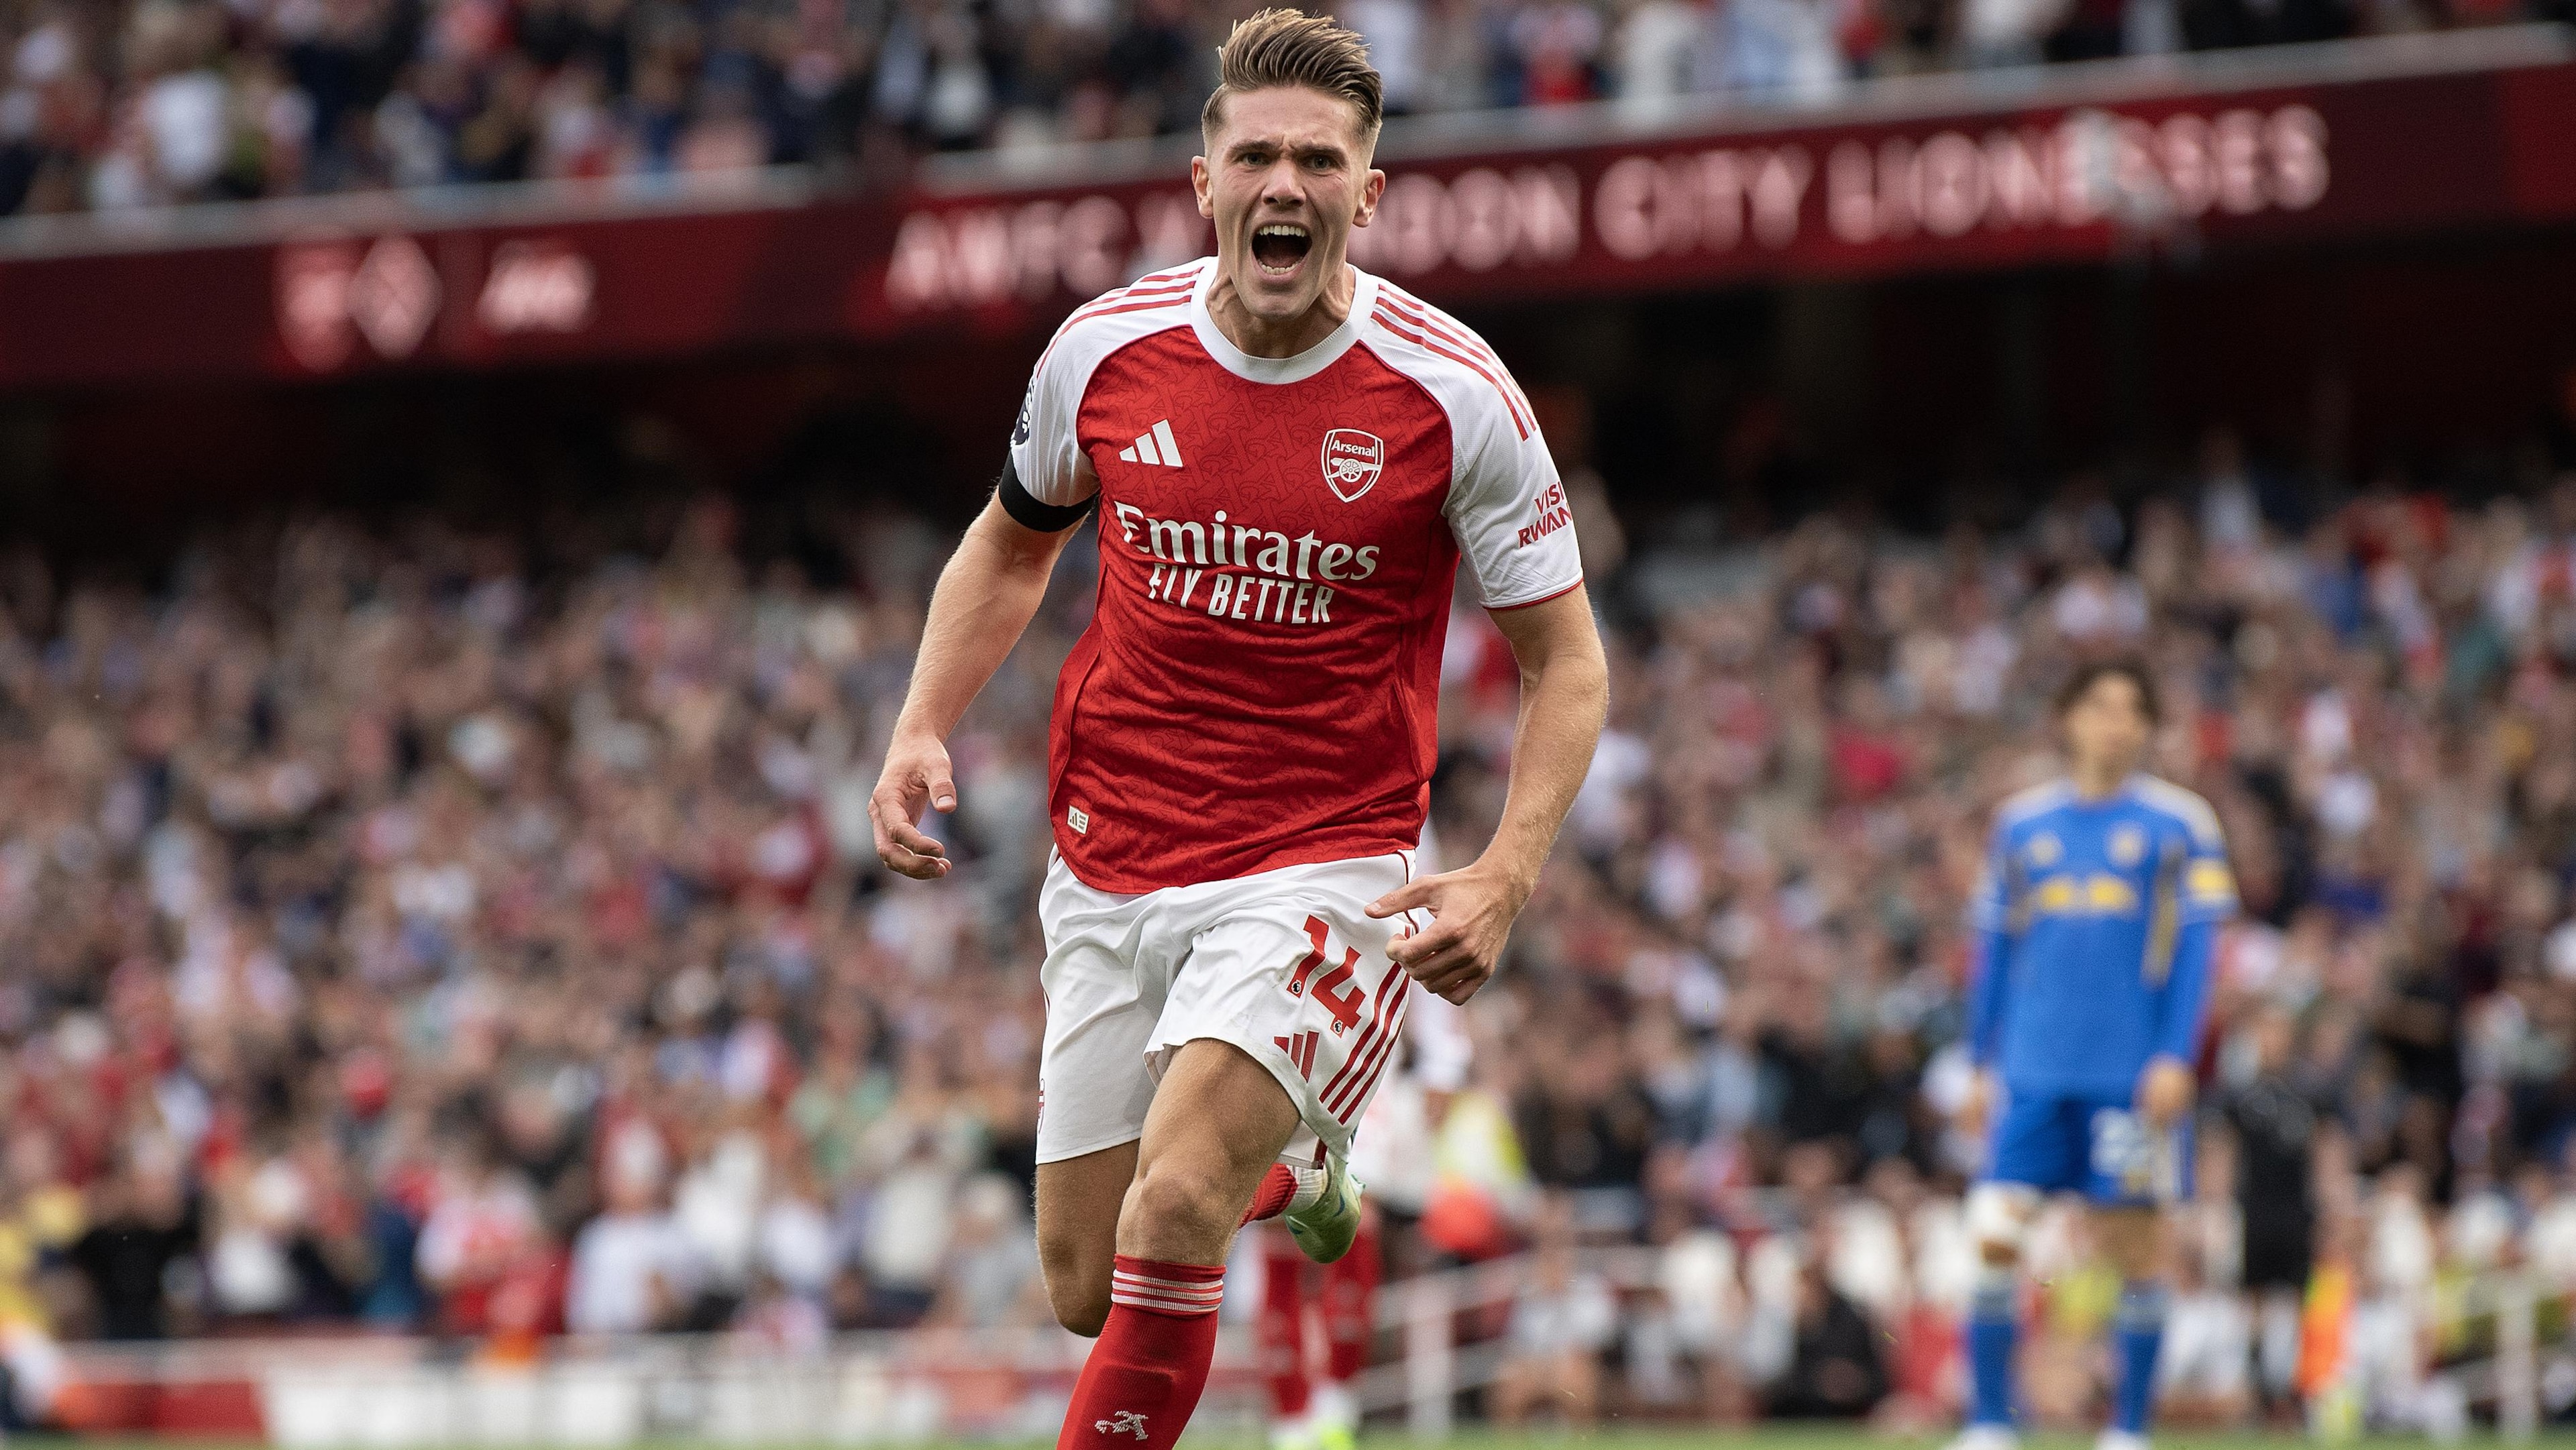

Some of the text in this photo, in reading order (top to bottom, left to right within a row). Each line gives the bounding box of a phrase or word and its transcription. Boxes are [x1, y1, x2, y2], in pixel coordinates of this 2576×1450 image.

[1346, 169, 1582, 276] DON
[1595, 142, 1814, 260] CITY
[1825, 104, 2330, 245] LIONESSES
[1331, 439, 1375, 457] Arsenal
[1517, 503, 1572, 549] RWAN
[1534, 481, 1566, 514] VISI
[1114, 500, 1380, 581] Emirates
[1148, 563, 1335, 624] FLY BETTER
[1286, 914, 1367, 1039] 14
